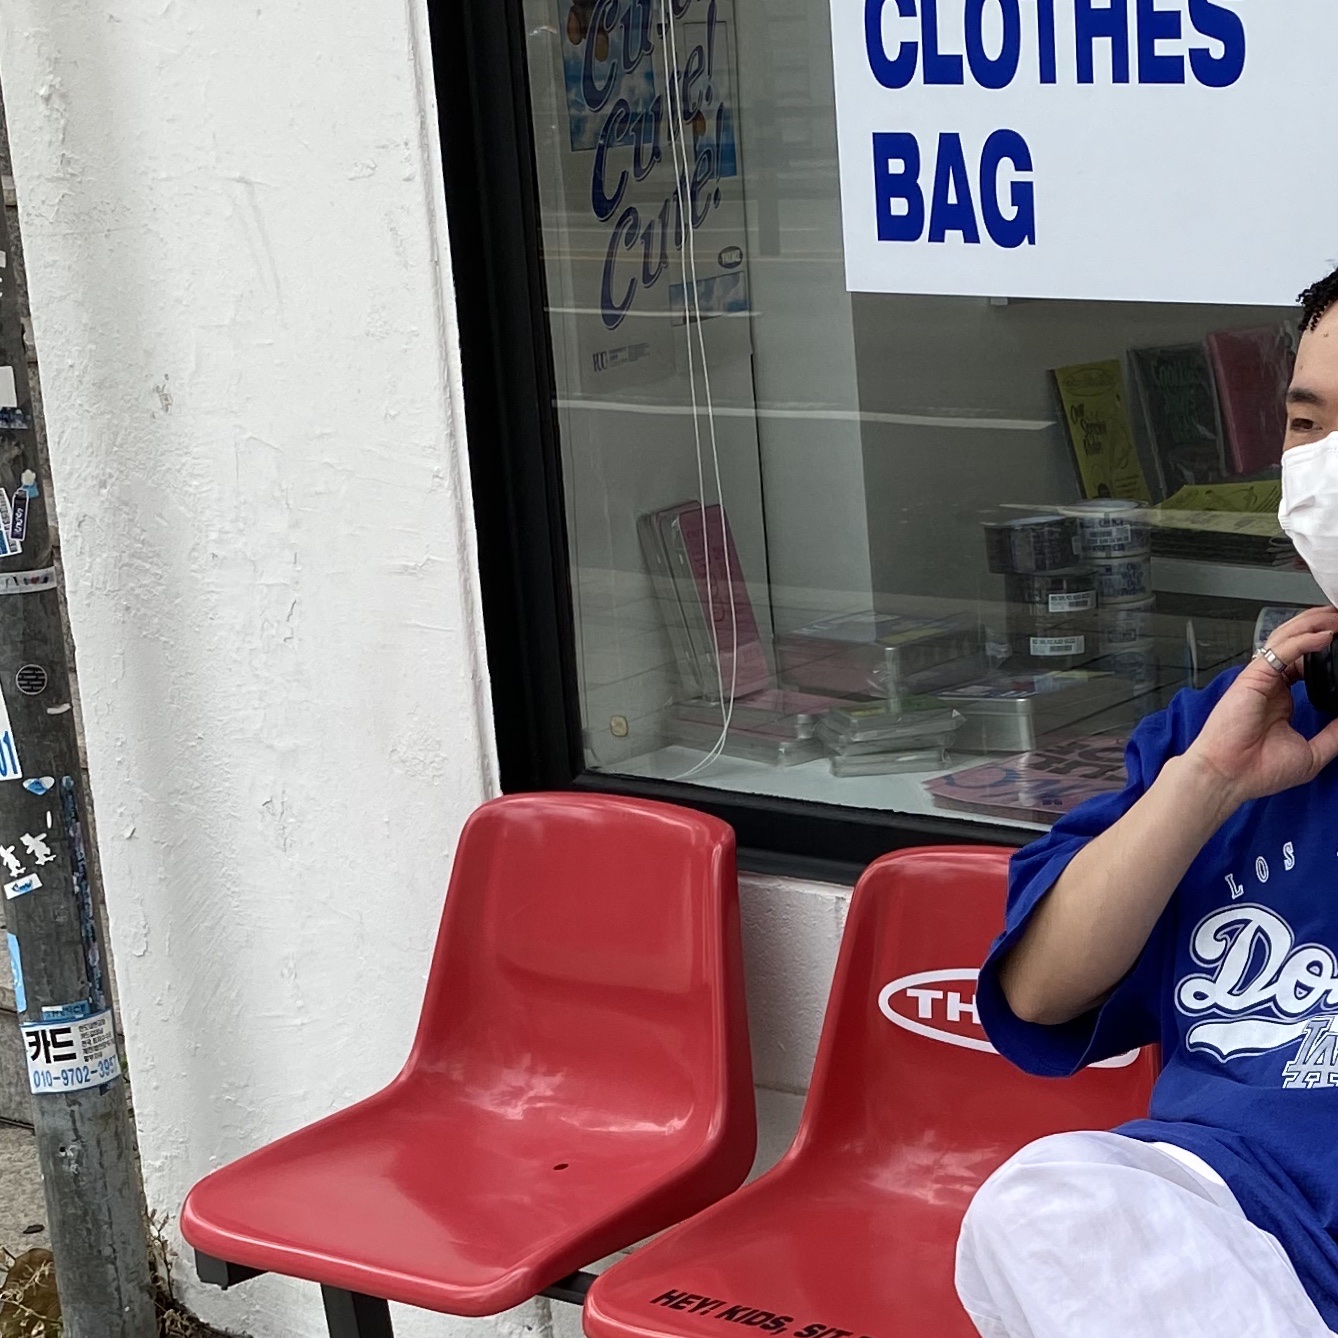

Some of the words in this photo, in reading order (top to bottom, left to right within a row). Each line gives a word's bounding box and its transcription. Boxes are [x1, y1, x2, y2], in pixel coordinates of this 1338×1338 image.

[864, 0, 1247, 90] CLOTHES
[872, 128, 1037, 249] BAG
[1225, 841, 1296, 899] LOS
[25, 1027, 77, 1064] 카드
[650, 1288, 726, 1316] HEY!
[714, 1304, 794, 1335] KIDS,
